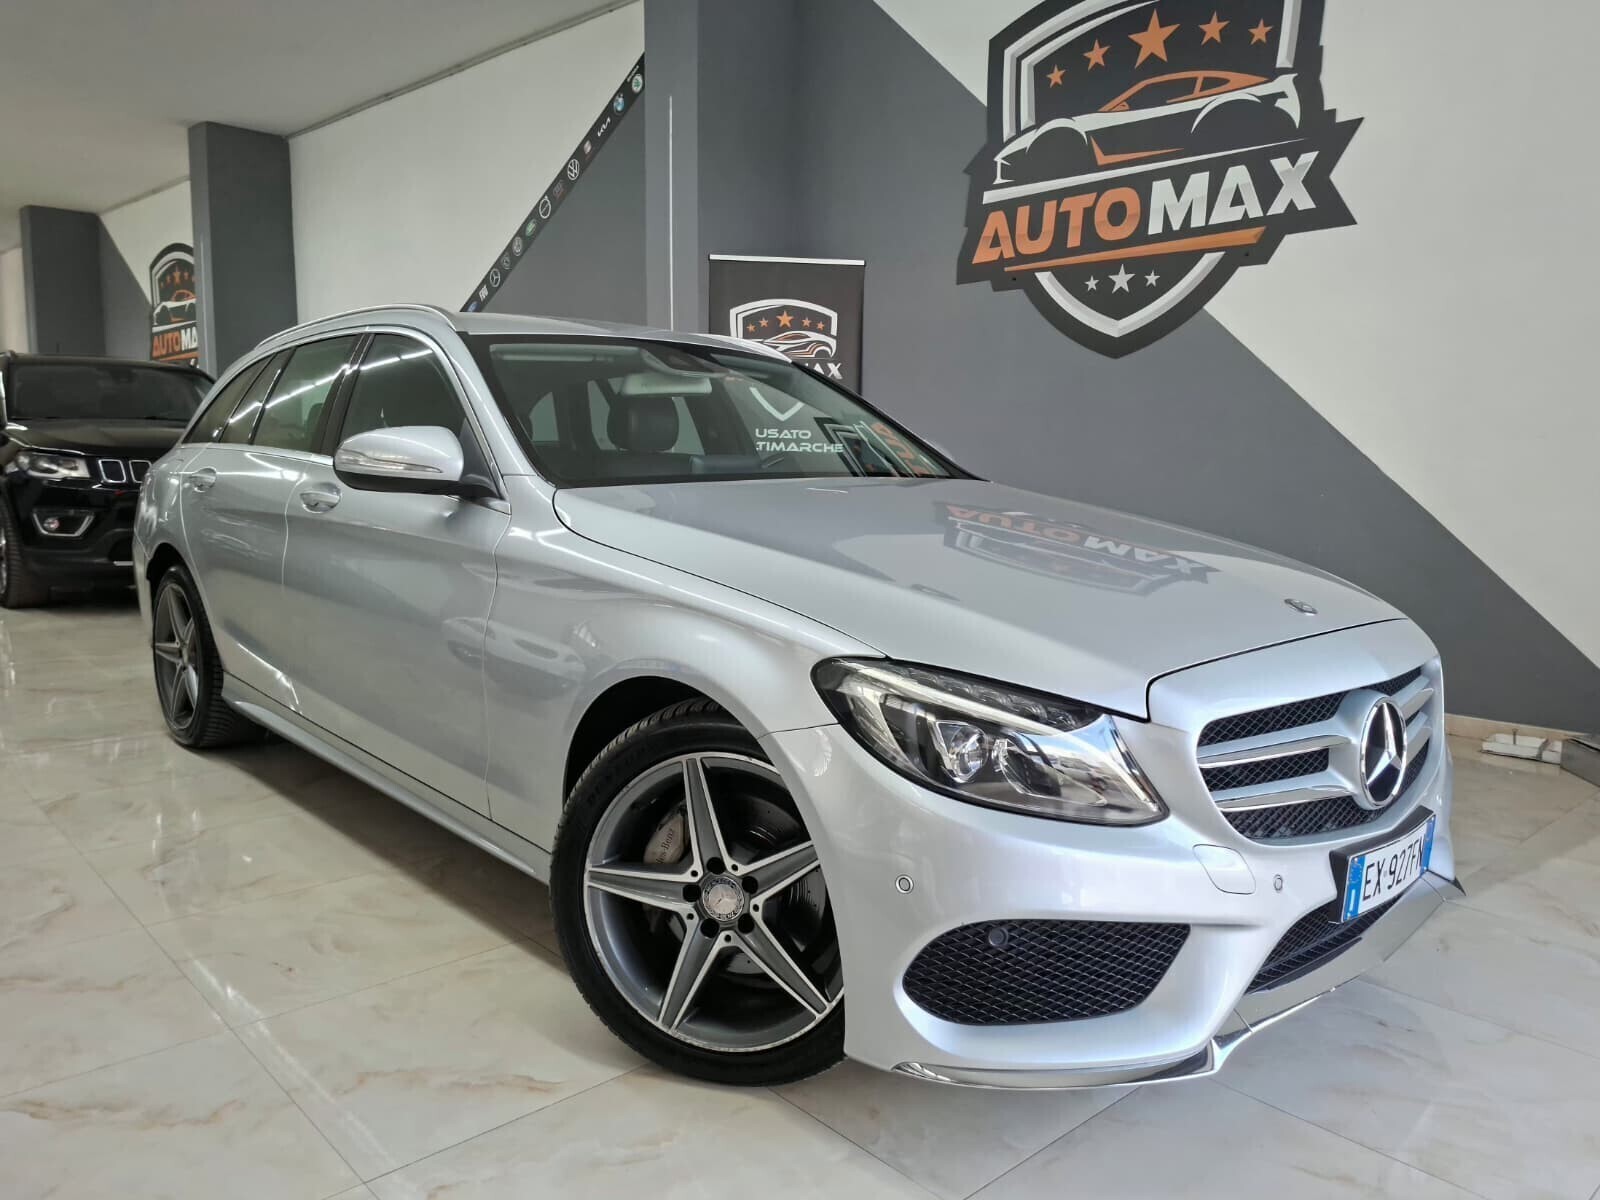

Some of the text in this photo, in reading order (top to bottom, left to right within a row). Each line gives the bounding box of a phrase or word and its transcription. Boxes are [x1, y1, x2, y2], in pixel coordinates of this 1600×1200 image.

[152, 326, 199, 358] AUTOMA
[755, 428, 812, 439] USATO
[756, 441, 844, 453] TIMARCHE
